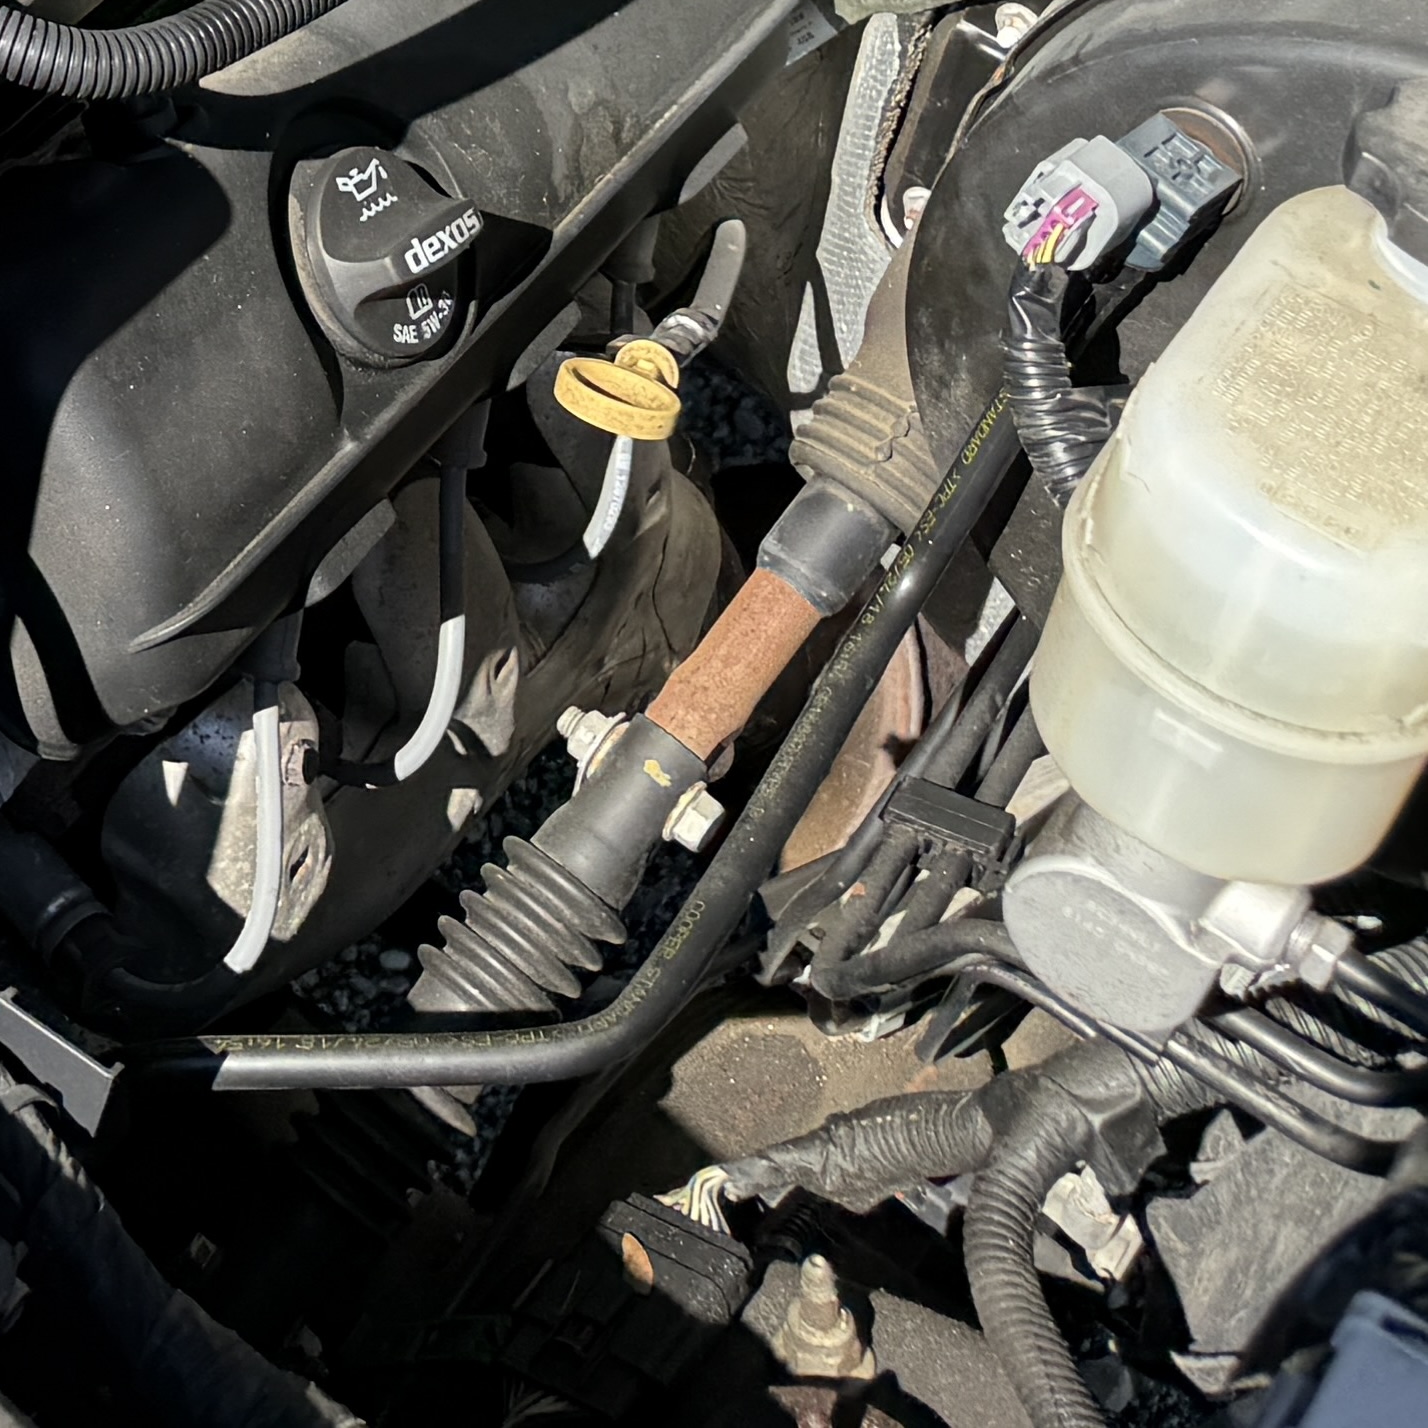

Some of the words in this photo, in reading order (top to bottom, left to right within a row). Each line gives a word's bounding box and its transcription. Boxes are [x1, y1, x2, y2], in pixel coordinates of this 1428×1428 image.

[403, 208, 481, 274] dexos
[392, 322, 418, 344] SAE
[656, 896, 709, 962] COOPER
